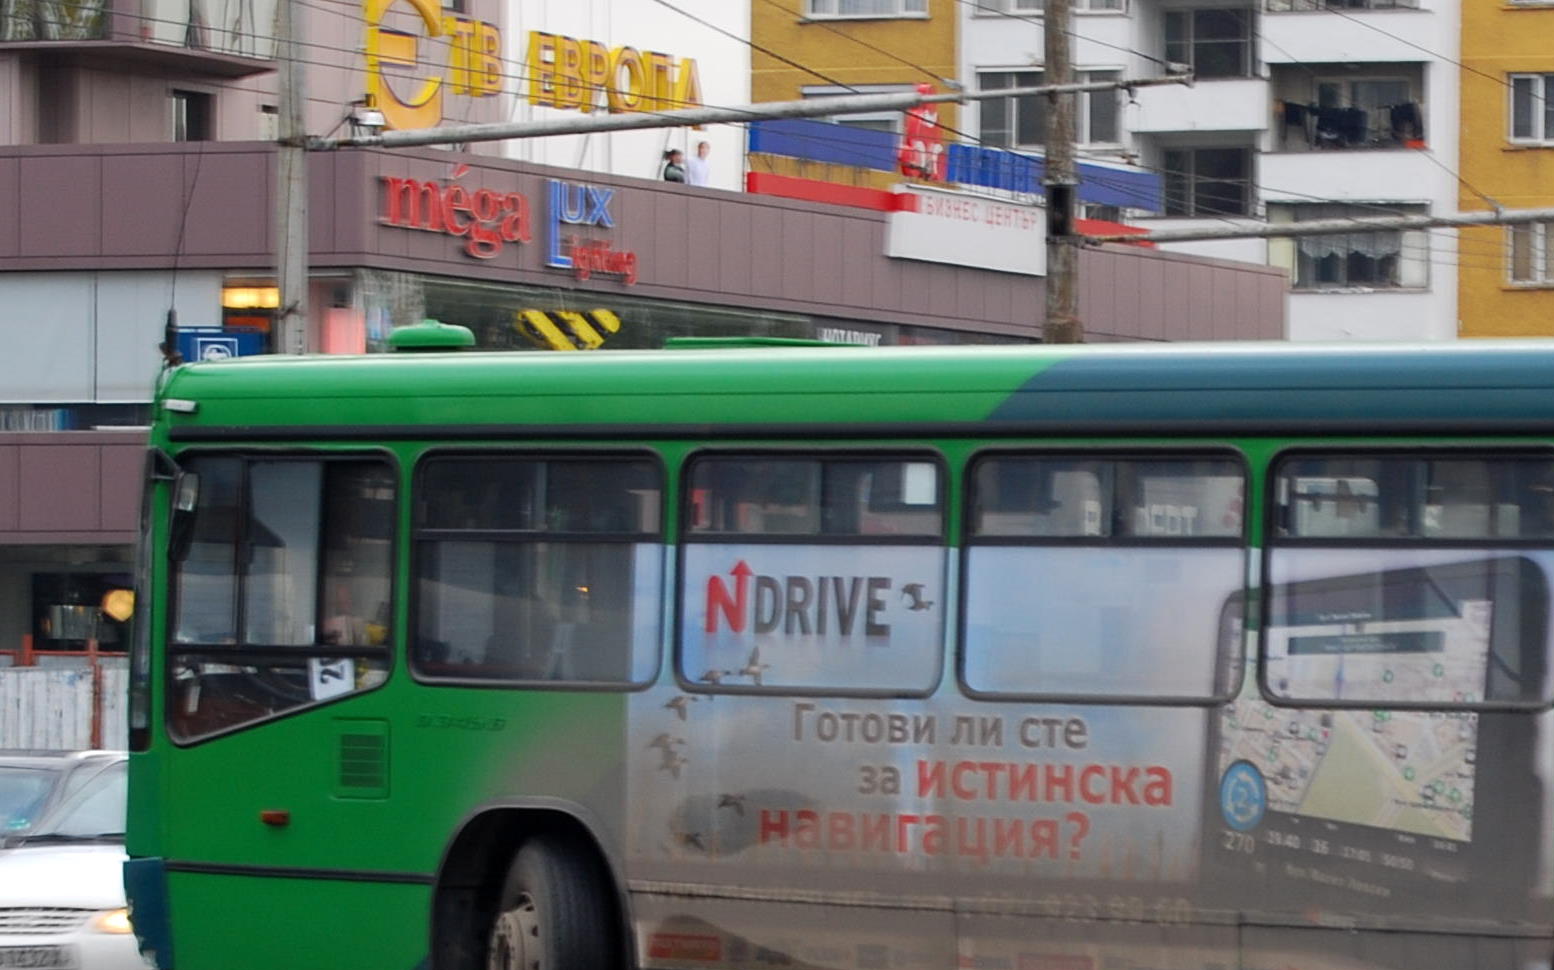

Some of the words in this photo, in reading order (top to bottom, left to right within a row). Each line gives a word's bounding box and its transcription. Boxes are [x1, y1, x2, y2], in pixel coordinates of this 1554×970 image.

[445, 17, 503, 97] ТВ
[528, 30, 704, 131] ЕВРОПА
[378, 164, 532, 259] méga
[926, 195, 978, 222] БИЗНЕС
[985, 203, 1037, 231] ЦЕНТЪР
[705, 560, 892, 636] NDRIVE
[794, 703, 936, 744] Готови
[950, 714, 1003, 747] ли
[1019, 716, 1088, 749] сте
[858, 762, 900, 796] за
[917, 759, 1173, 806] истинска
[759, 806, 1090, 861] навигация?
